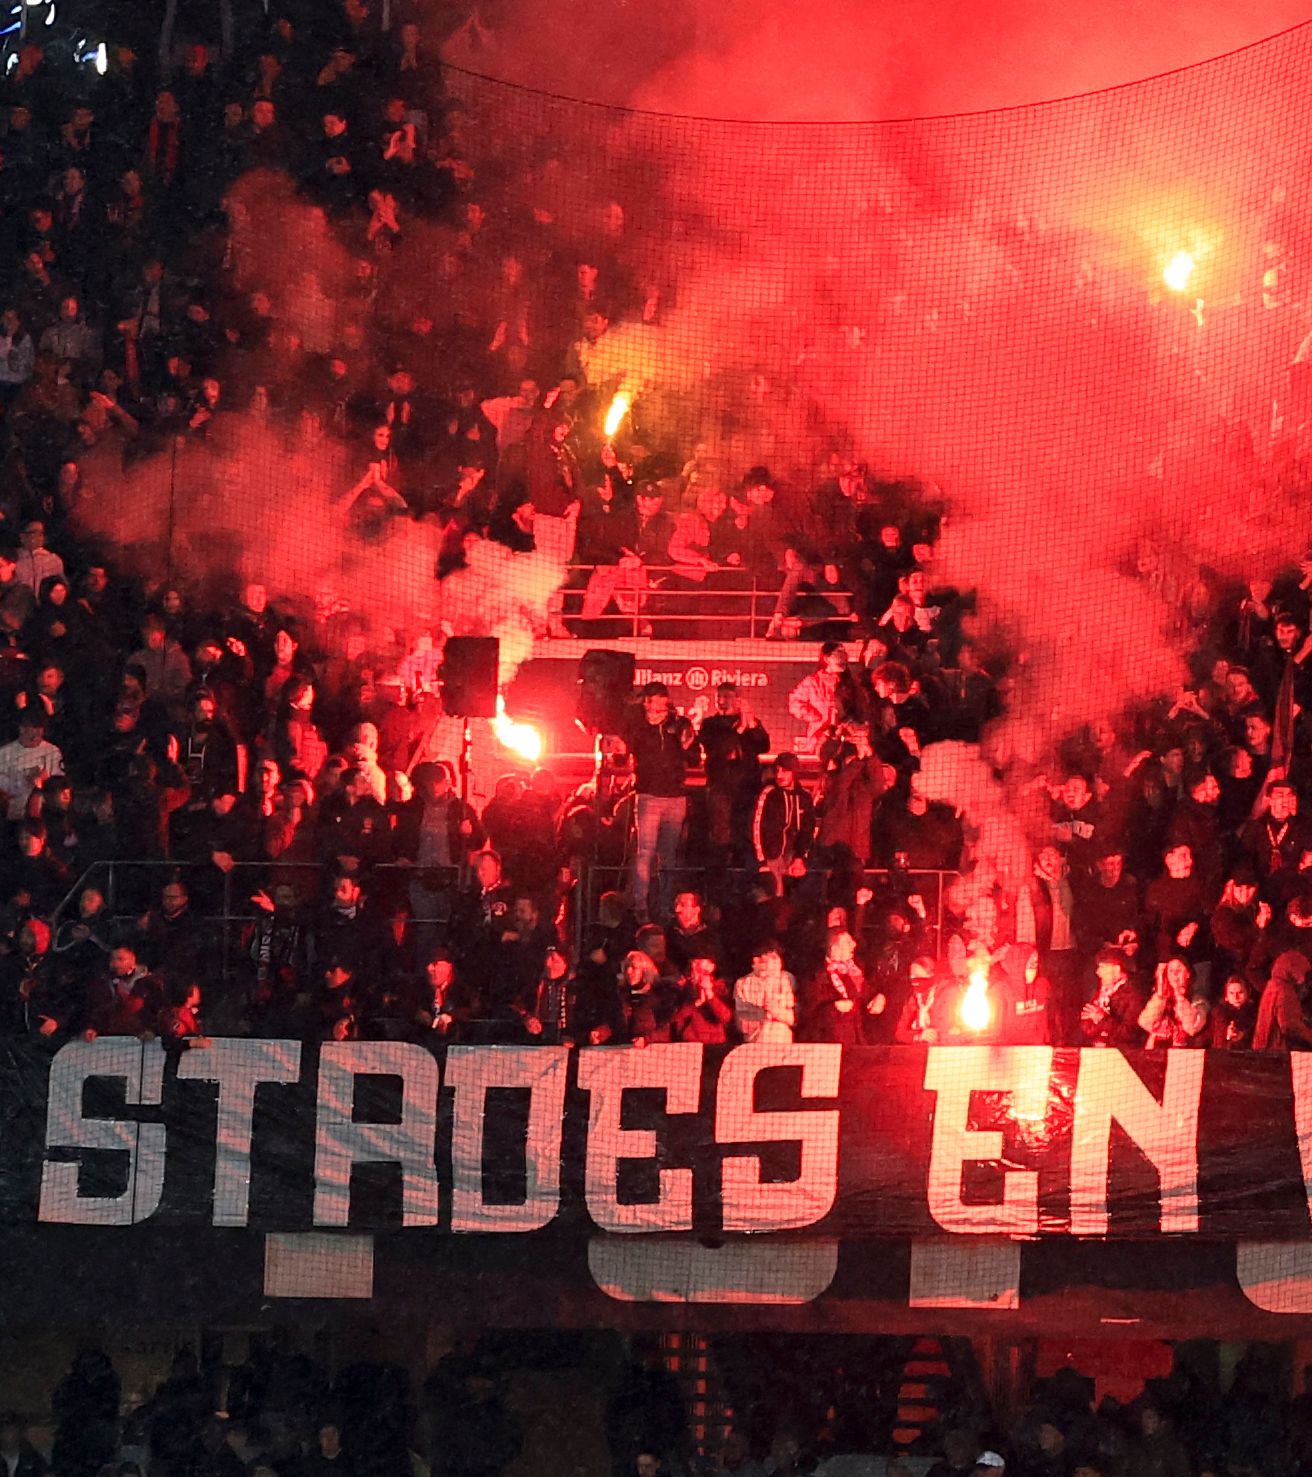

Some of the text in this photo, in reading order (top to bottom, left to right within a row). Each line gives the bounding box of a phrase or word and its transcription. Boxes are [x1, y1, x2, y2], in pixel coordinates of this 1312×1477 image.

[634, 669, 768, 687] llianz Riviera
[37, 1036, 842, 1233] STADES
[923, 1045, 1206, 1235] EN
